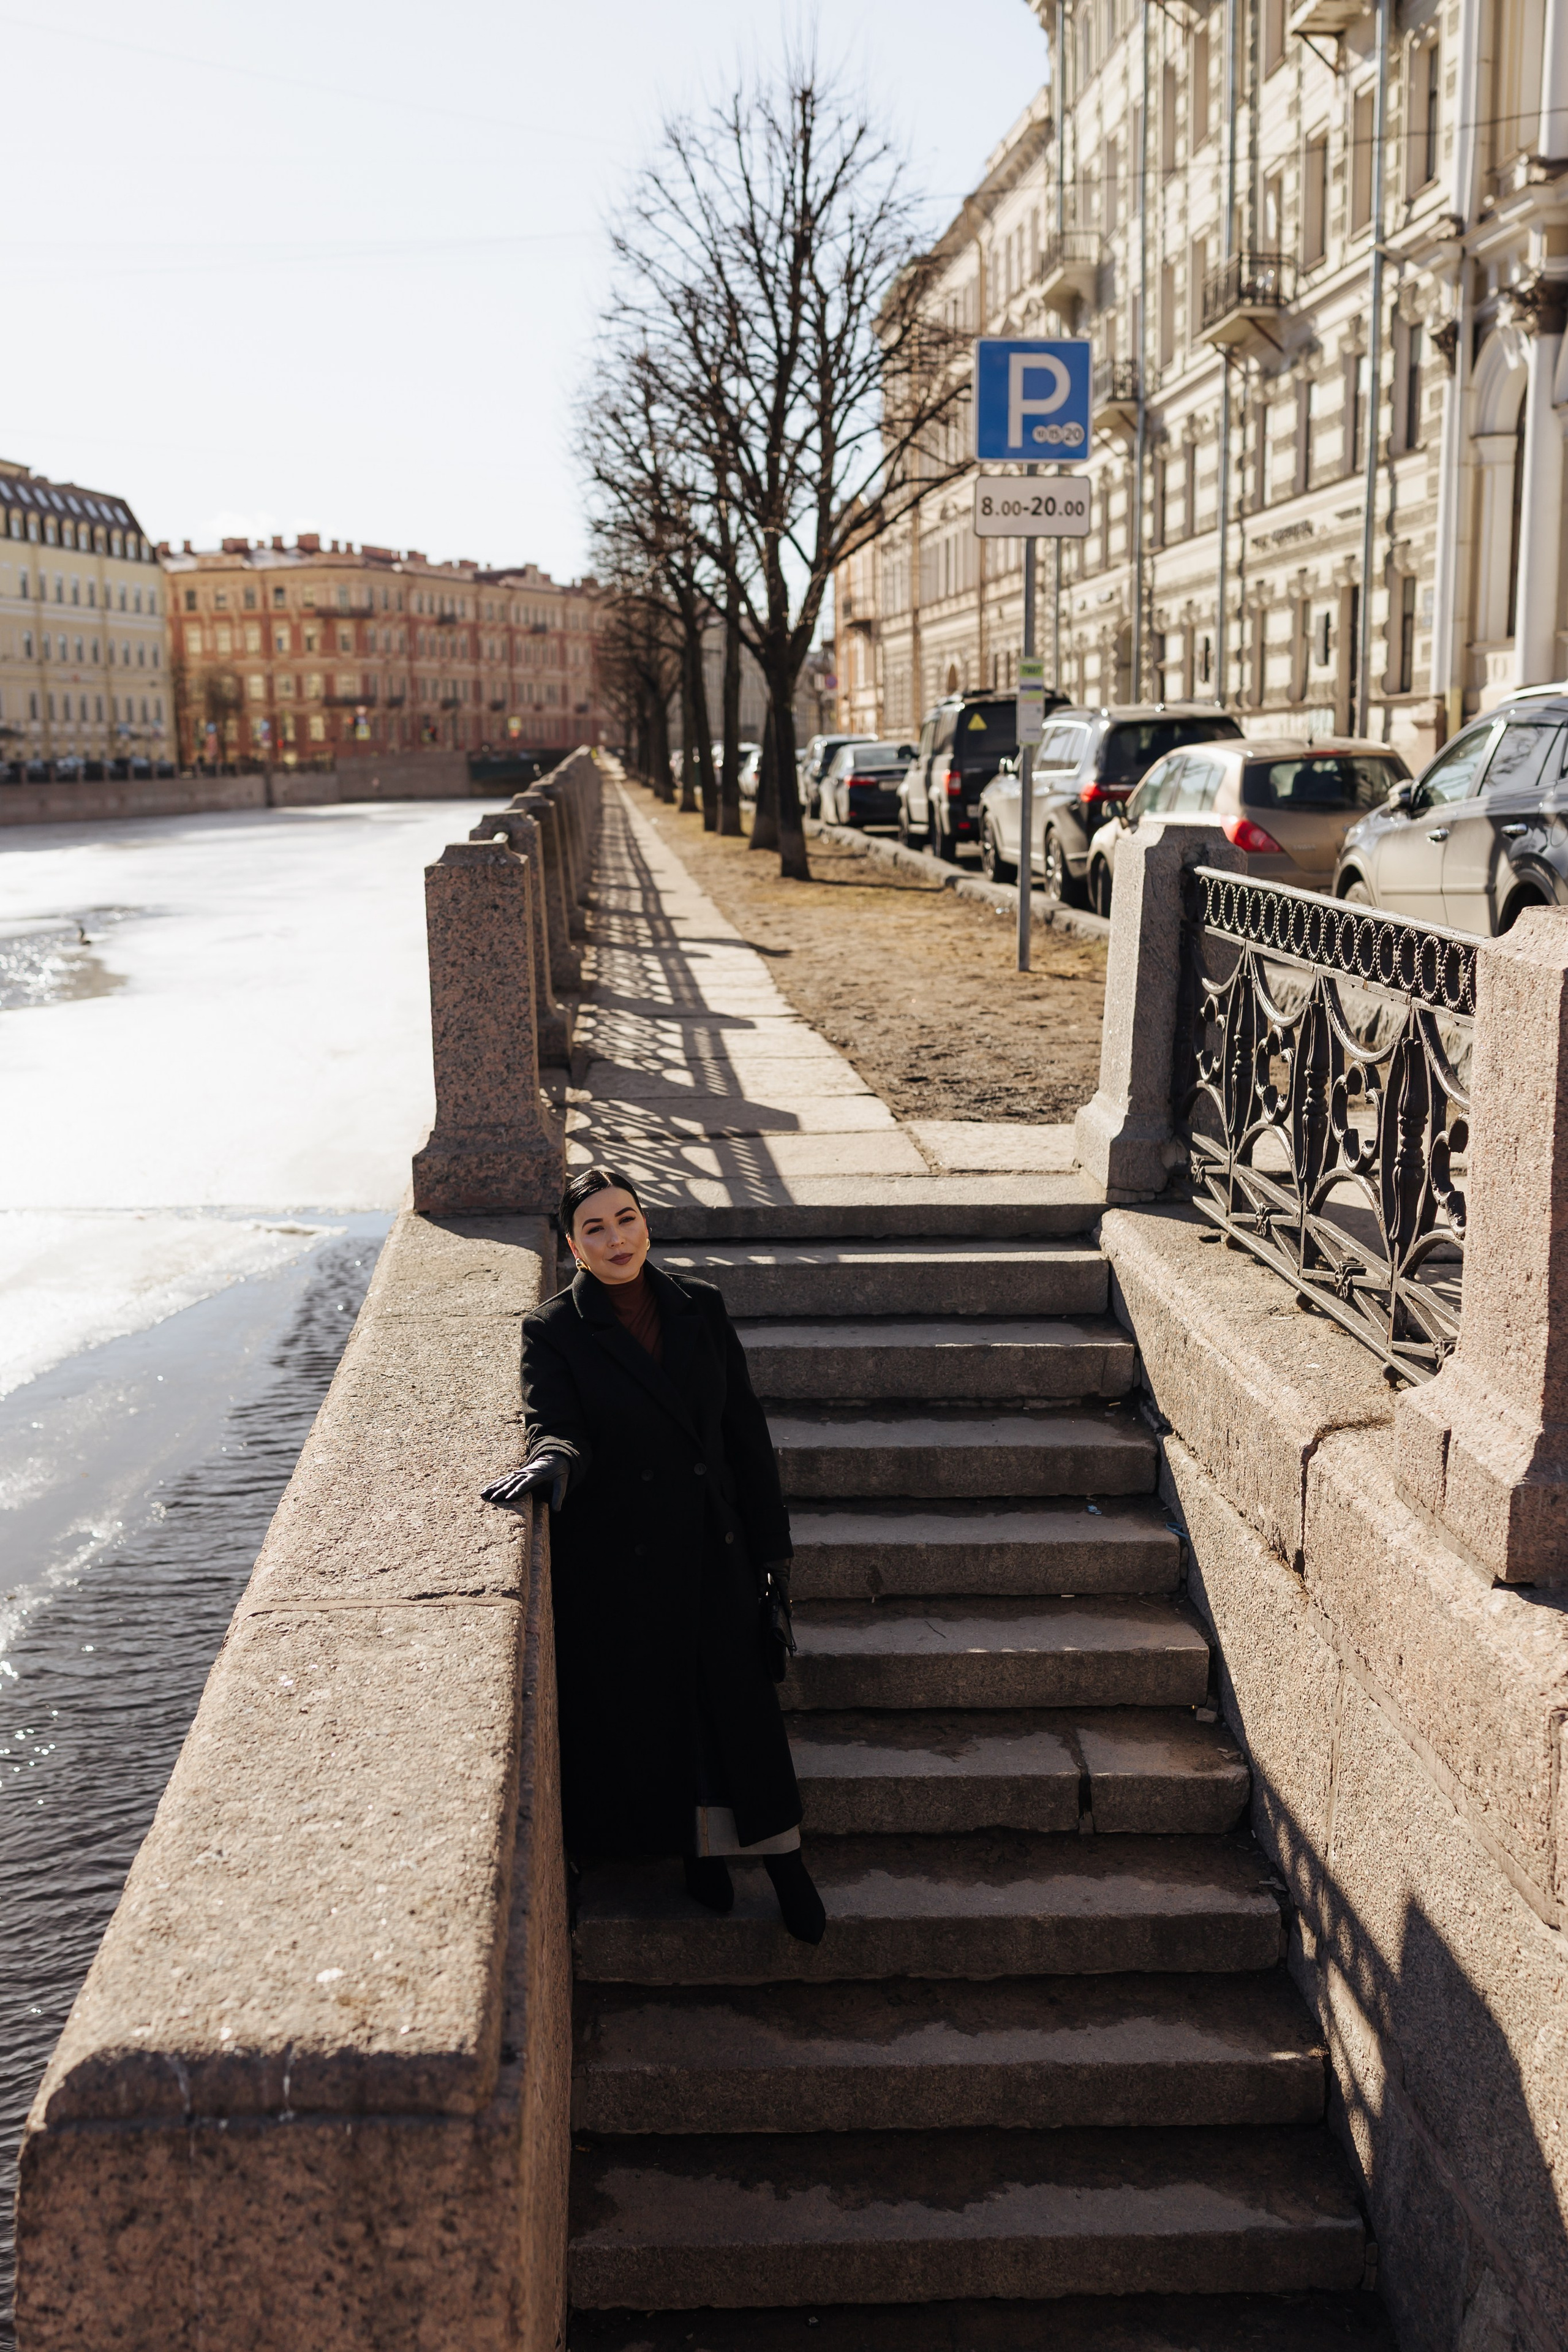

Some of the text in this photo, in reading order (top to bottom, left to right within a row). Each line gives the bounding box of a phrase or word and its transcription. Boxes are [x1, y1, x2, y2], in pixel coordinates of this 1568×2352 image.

[1008, 352, 1071, 448] P
[1065, 428, 1082, 440] 20
[981, 496, 1085, 516] 8.00-20.00
